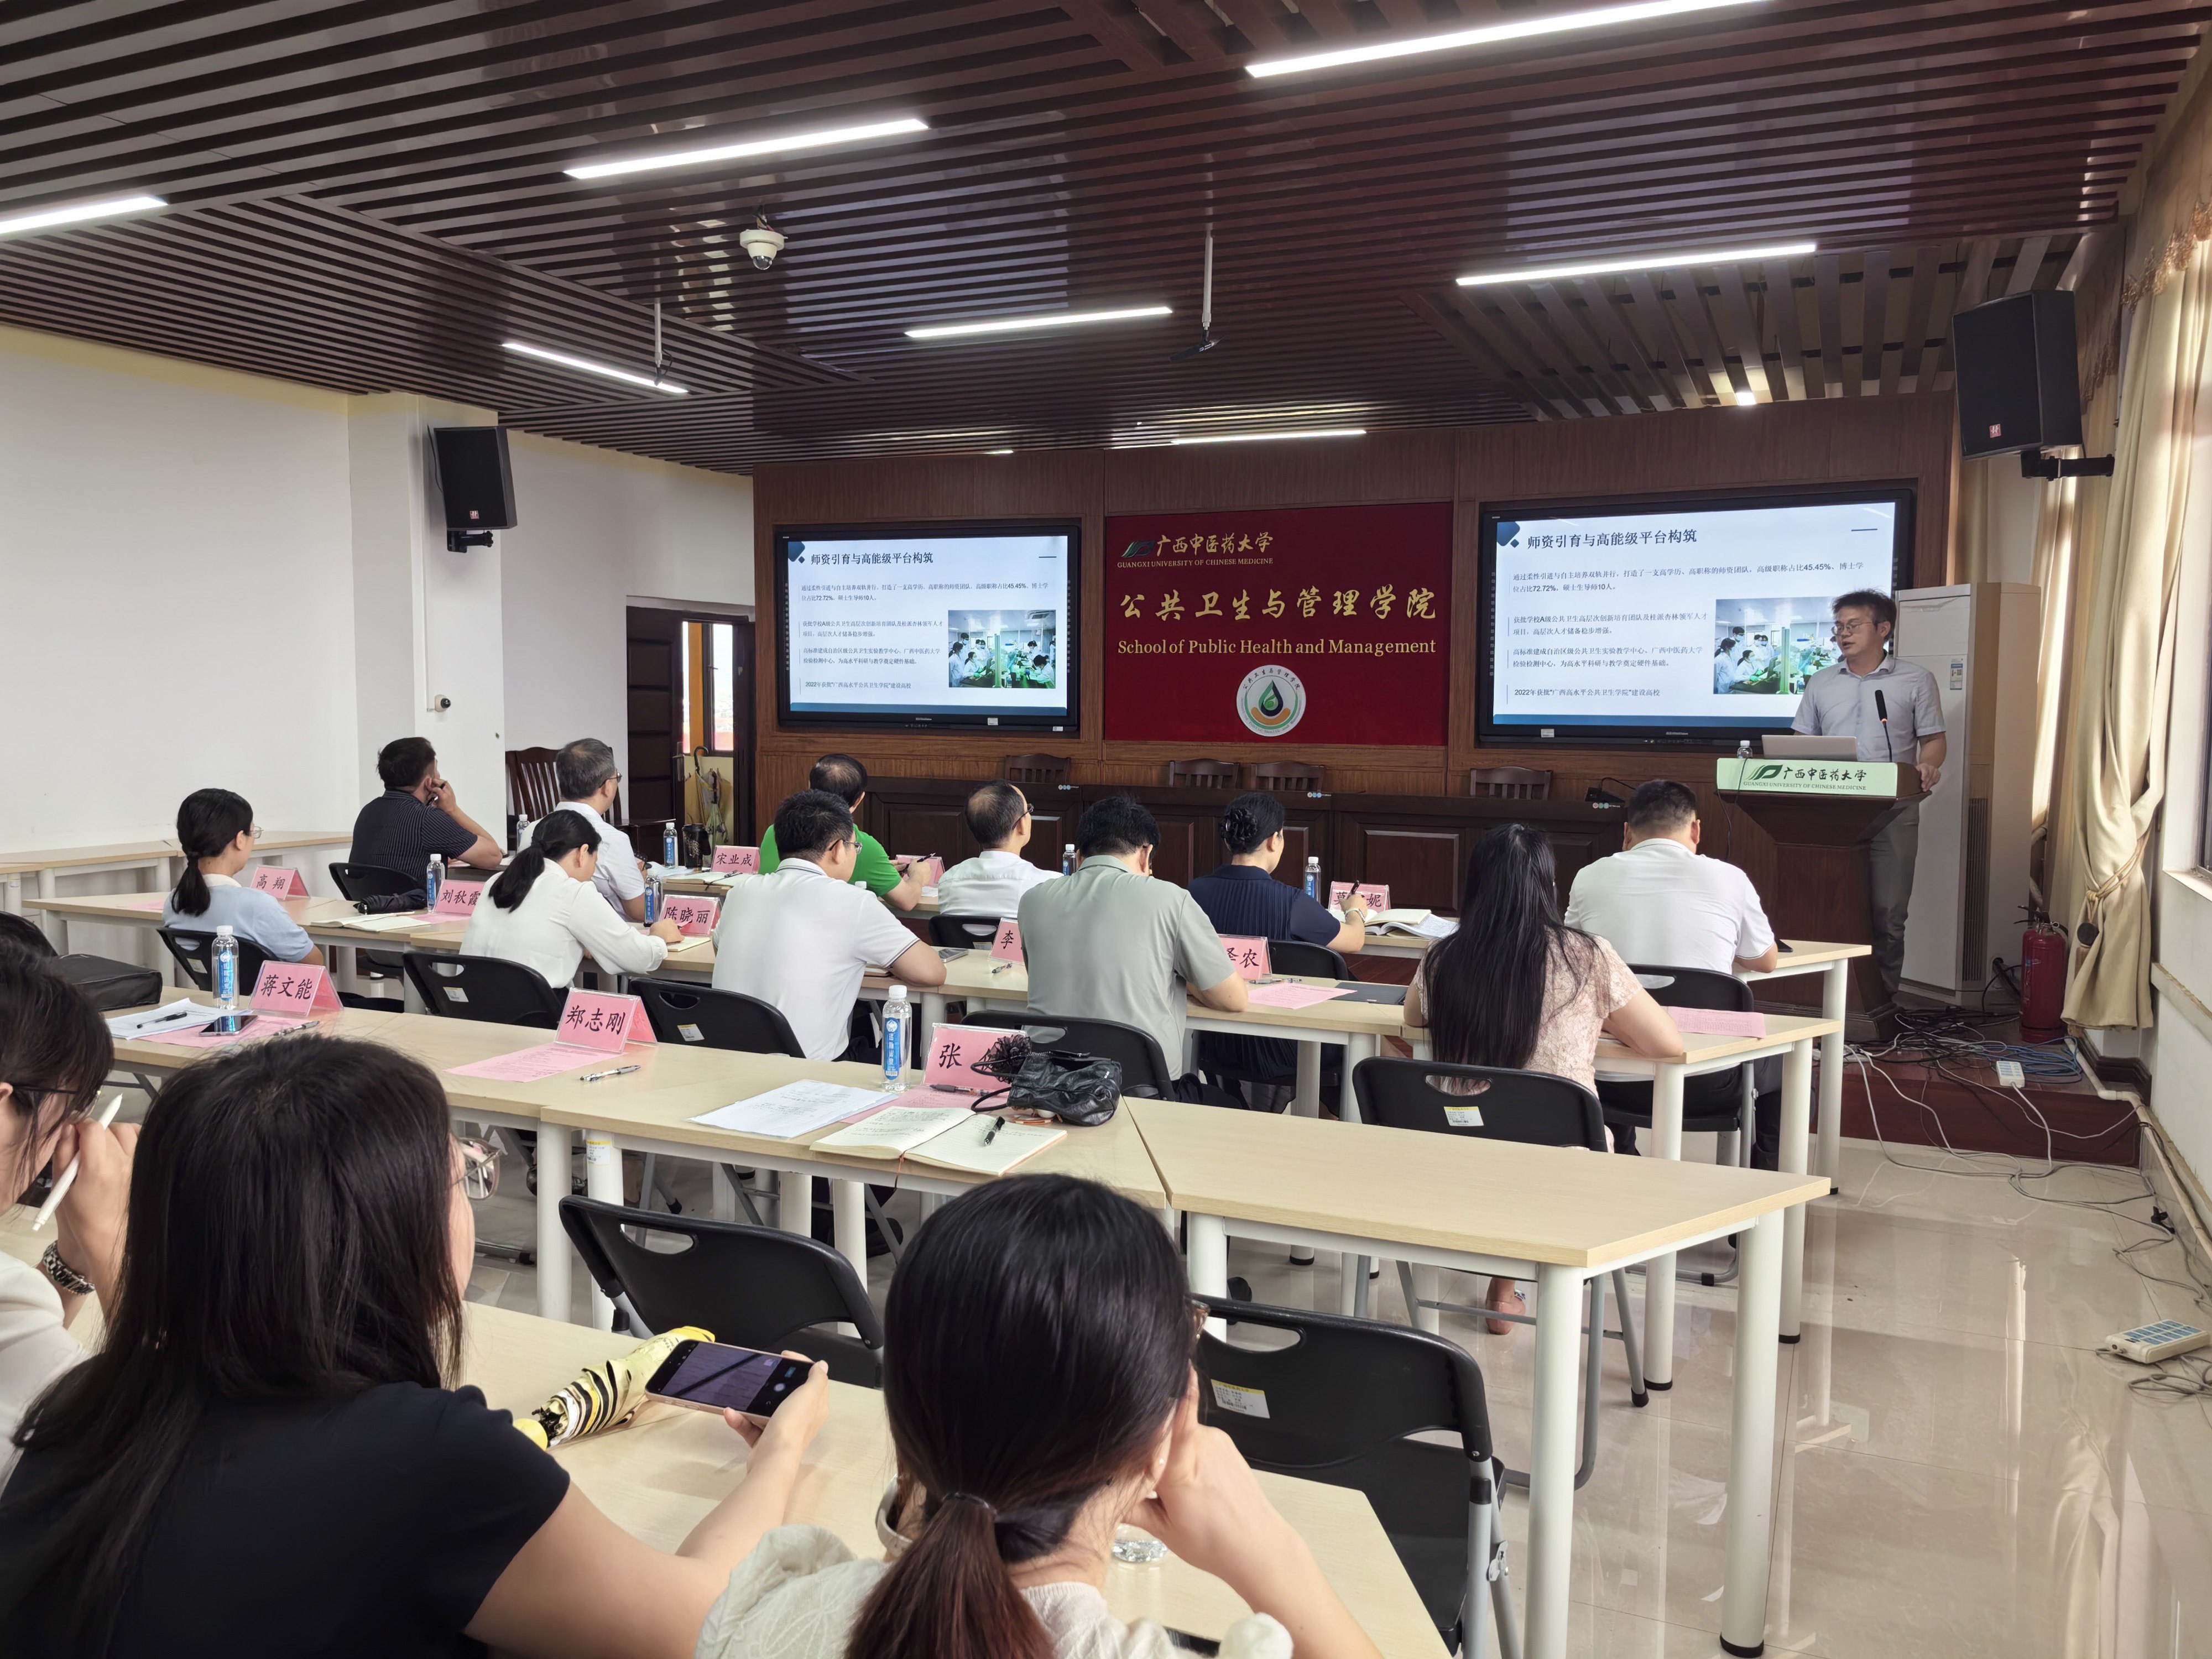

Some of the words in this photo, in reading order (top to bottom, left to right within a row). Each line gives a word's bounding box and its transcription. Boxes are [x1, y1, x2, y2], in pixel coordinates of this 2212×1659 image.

[1157, 532, 1273, 556] 广西中医药大学
[1527, 528, 1697, 549] 师资引育与高能级平台构筑
[810, 551, 933, 565] 师资引育与高能级平台构筑
[1120, 583, 1436, 620] 公共卫生与管理学院
[1118, 640, 1166, 654] School
[1169, 639, 1184, 654] of
[1188, 639, 1236, 654] Public
[1240, 639, 1292, 654] Health
[1296, 639, 1324, 654] and
[1328, 639, 1436, 656] Management
[1784, 767, 1866, 781] 广西中医药大学
[716, 853, 752, 867] 宋业成
[257, 874, 285, 890] 高翔
[440, 889, 481, 906] 刘秋霞
[1334, 891, 1381, 907] 莫妮
[664, 906, 710, 924] 陈晓丽
[1001, 930, 1022, 950] 李
[261, 974, 312, 999] 蒋文能
[566, 1005, 626, 1035] 郑志刚
